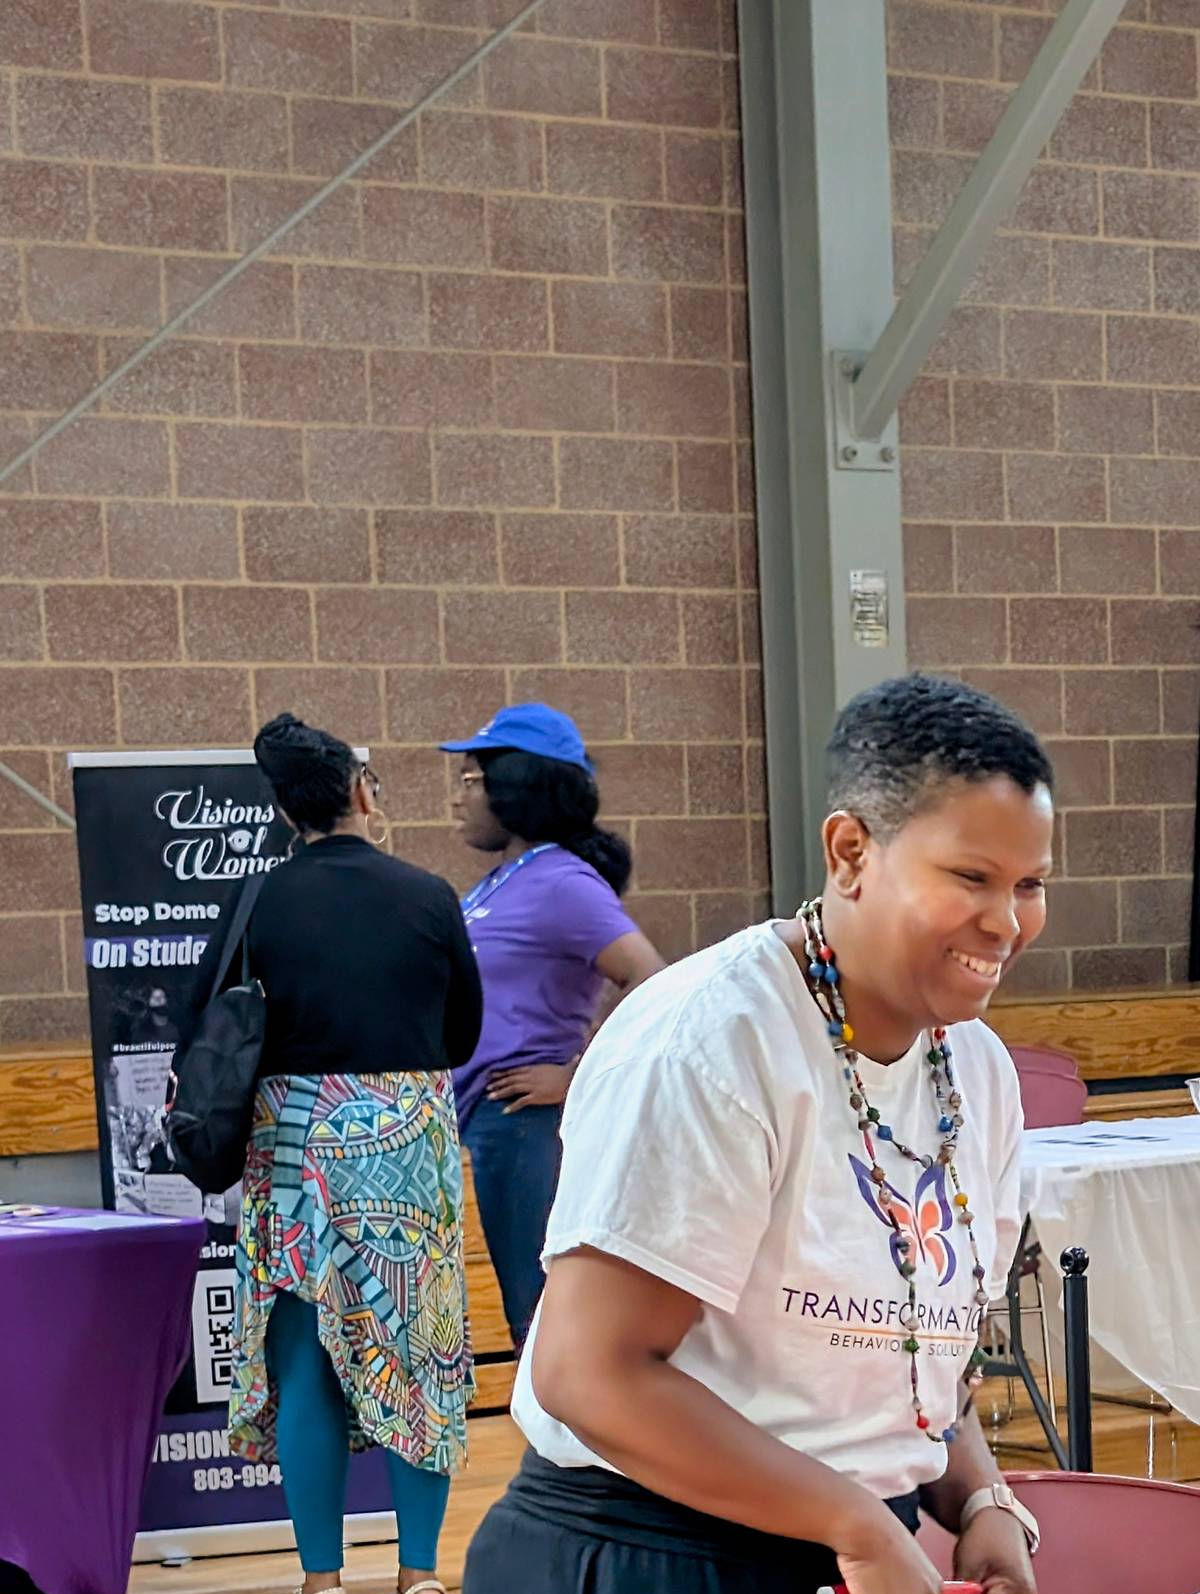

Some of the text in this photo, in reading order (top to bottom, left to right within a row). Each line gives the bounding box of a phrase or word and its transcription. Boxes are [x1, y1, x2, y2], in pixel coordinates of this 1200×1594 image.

[155, 784, 276, 829] Visions
[163, 832, 286, 880] Wome
[95, 902, 220, 925] Stop Dome
[92, 938, 127, 968] On
[152, 1429, 238, 1463] ISION
[193, 1463, 283, 1492] 803-994
